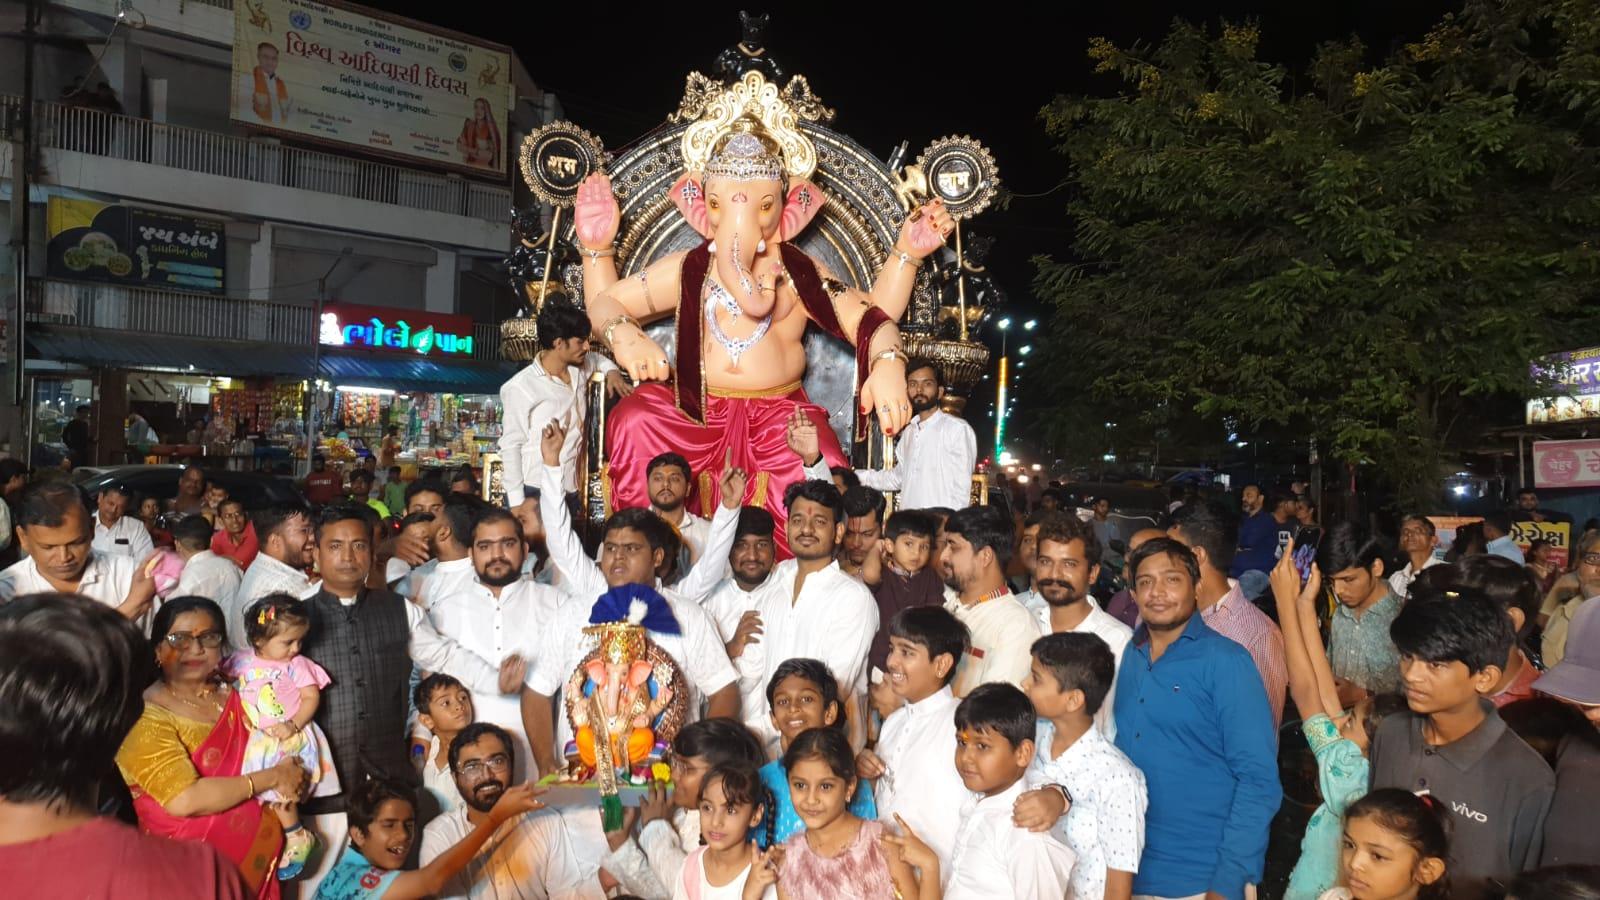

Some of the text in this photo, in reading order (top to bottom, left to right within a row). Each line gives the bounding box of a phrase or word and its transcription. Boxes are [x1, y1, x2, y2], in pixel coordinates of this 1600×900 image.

[323, 18, 353, 31] WORLD'S
[355, 26, 396, 42] INDIGENOUS
[397, 36, 426, 50] PEOPLES
[286, 31, 468, 96] વિશ્વ આદિવાસી દિવસ
[139, 225, 174, 243] જય
[343, 317, 473, 354] ભોલે પાન
[1451, 801, 1488, 823] vivo
